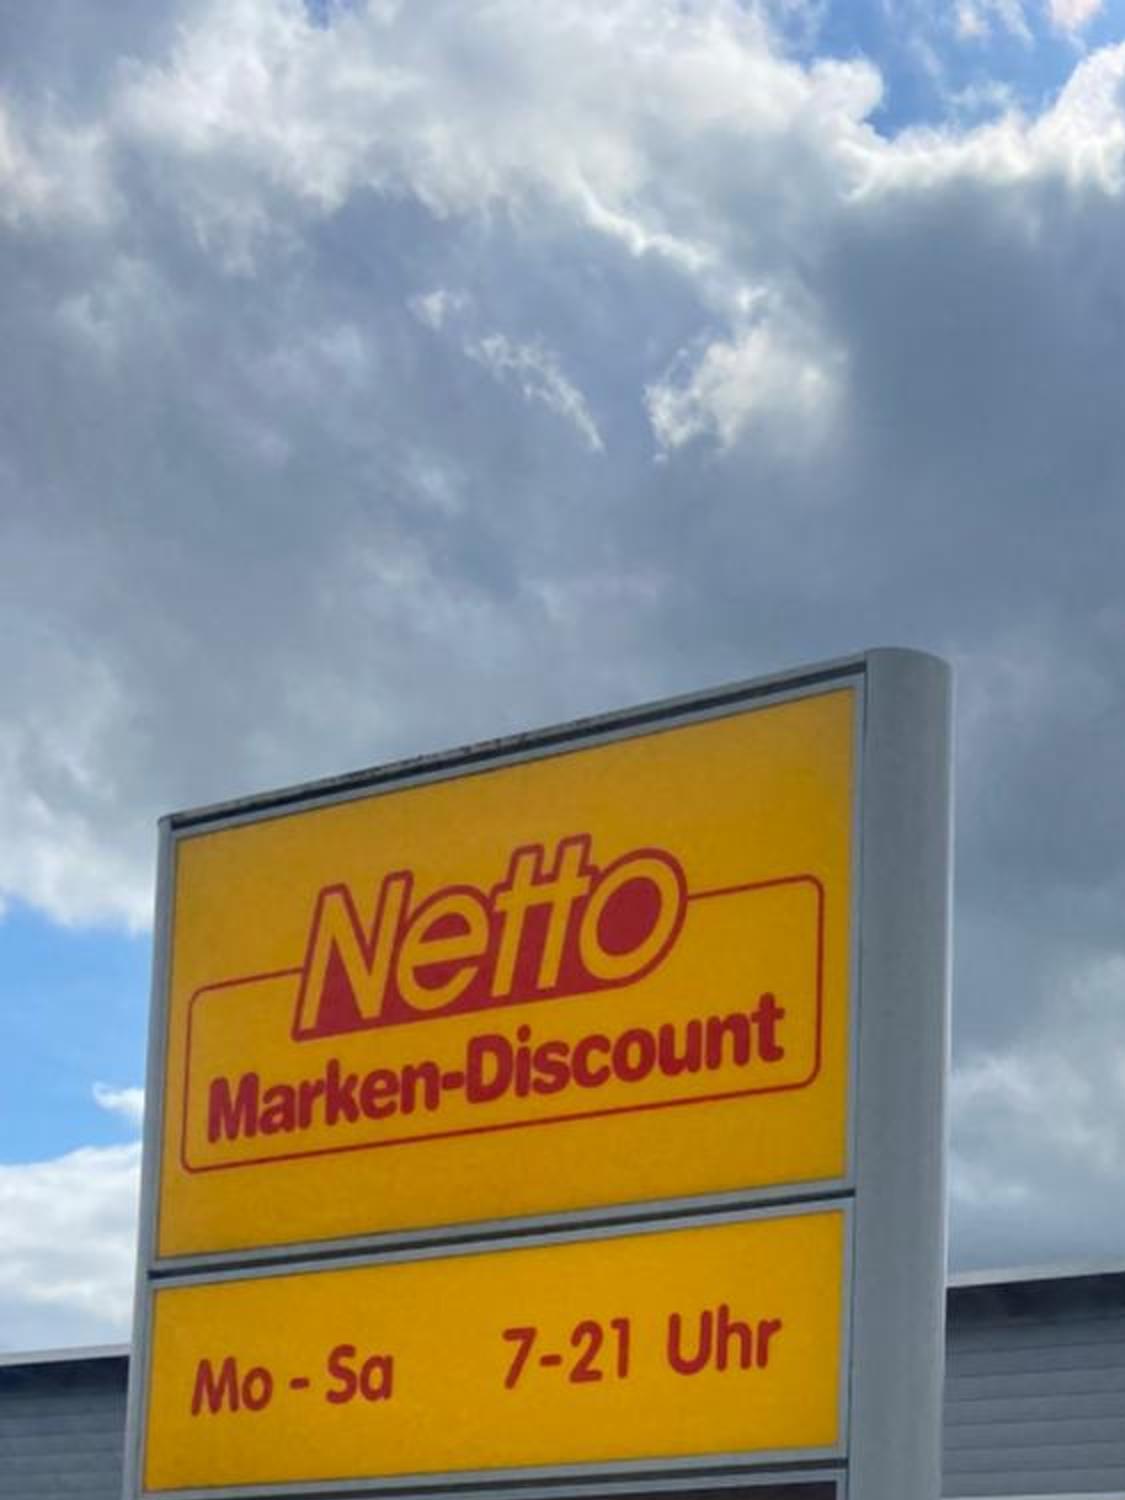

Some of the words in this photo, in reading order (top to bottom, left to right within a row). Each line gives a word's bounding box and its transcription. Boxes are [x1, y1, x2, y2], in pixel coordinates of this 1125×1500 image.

[292, 833, 688, 1041] Netto
[207, 992, 785, 1144] Marken-Discount
[191, 1356, 273, 1416] Mo
[325, 1344, 394, 1405] Sa
[502, 1318, 630, 1390] 7-21
[666, 1304, 783, 1376] Uhr
